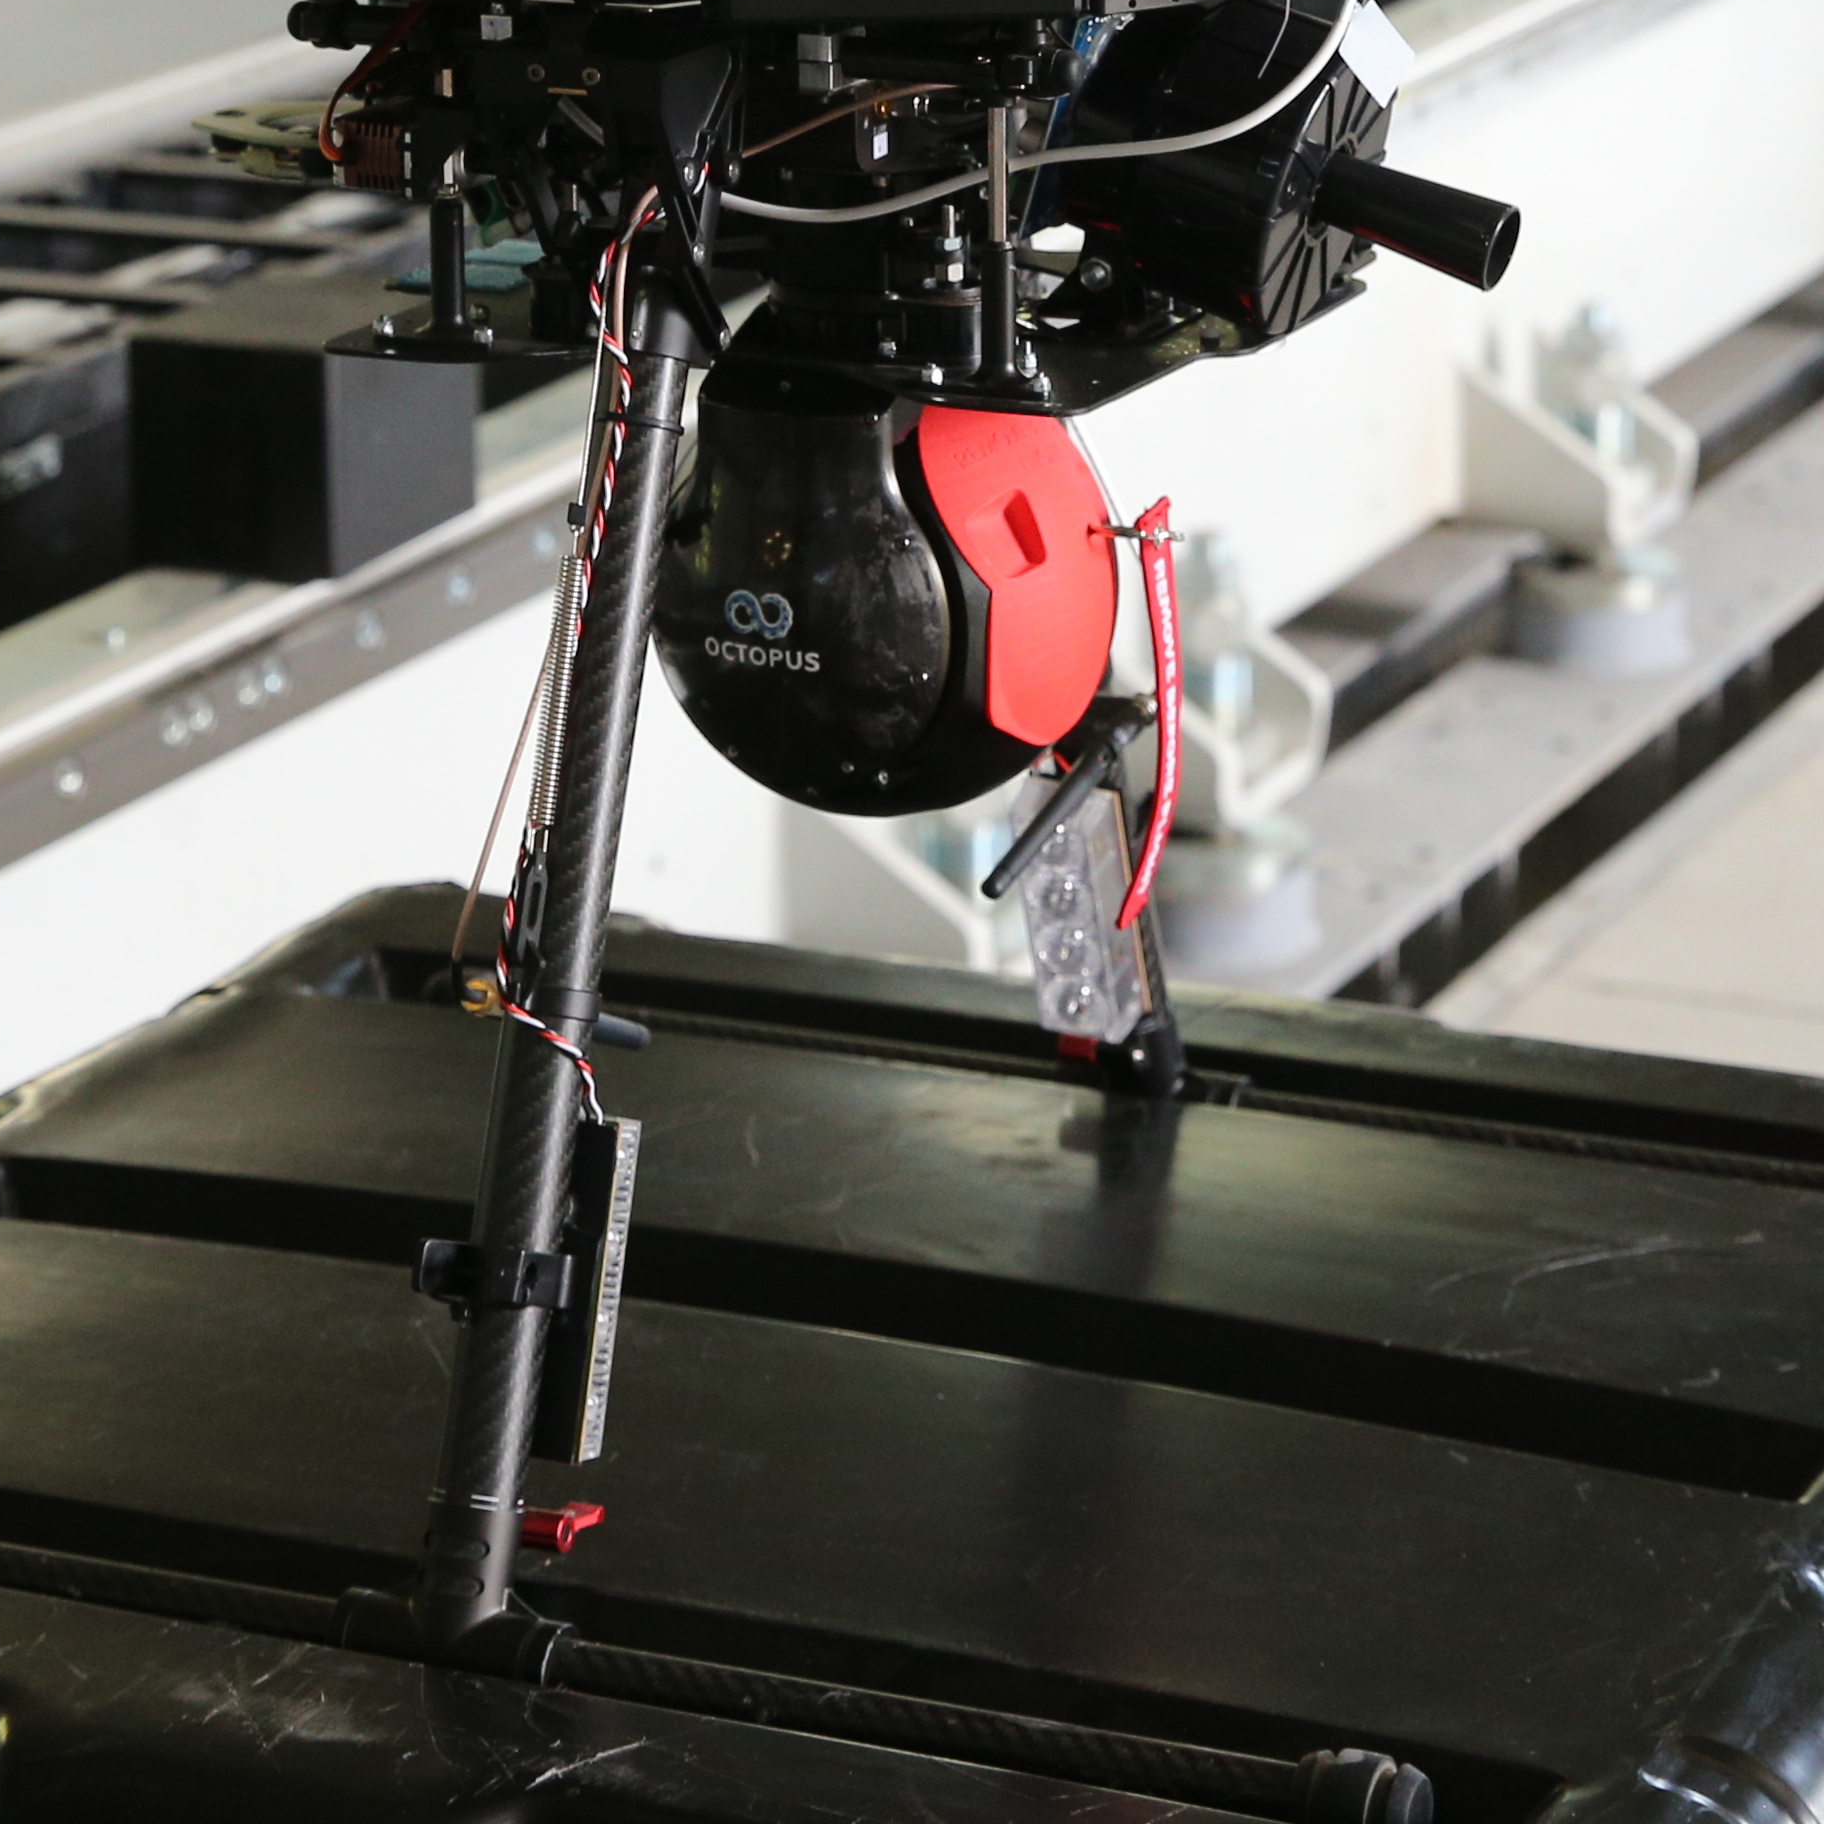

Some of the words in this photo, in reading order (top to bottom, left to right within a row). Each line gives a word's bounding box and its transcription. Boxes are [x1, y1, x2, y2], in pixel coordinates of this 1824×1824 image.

[704, 635, 821, 673] OCTOPUS
[1153, 556, 1176, 684] REMOVE
[1162, 684, 1177, 800] BEFORE
